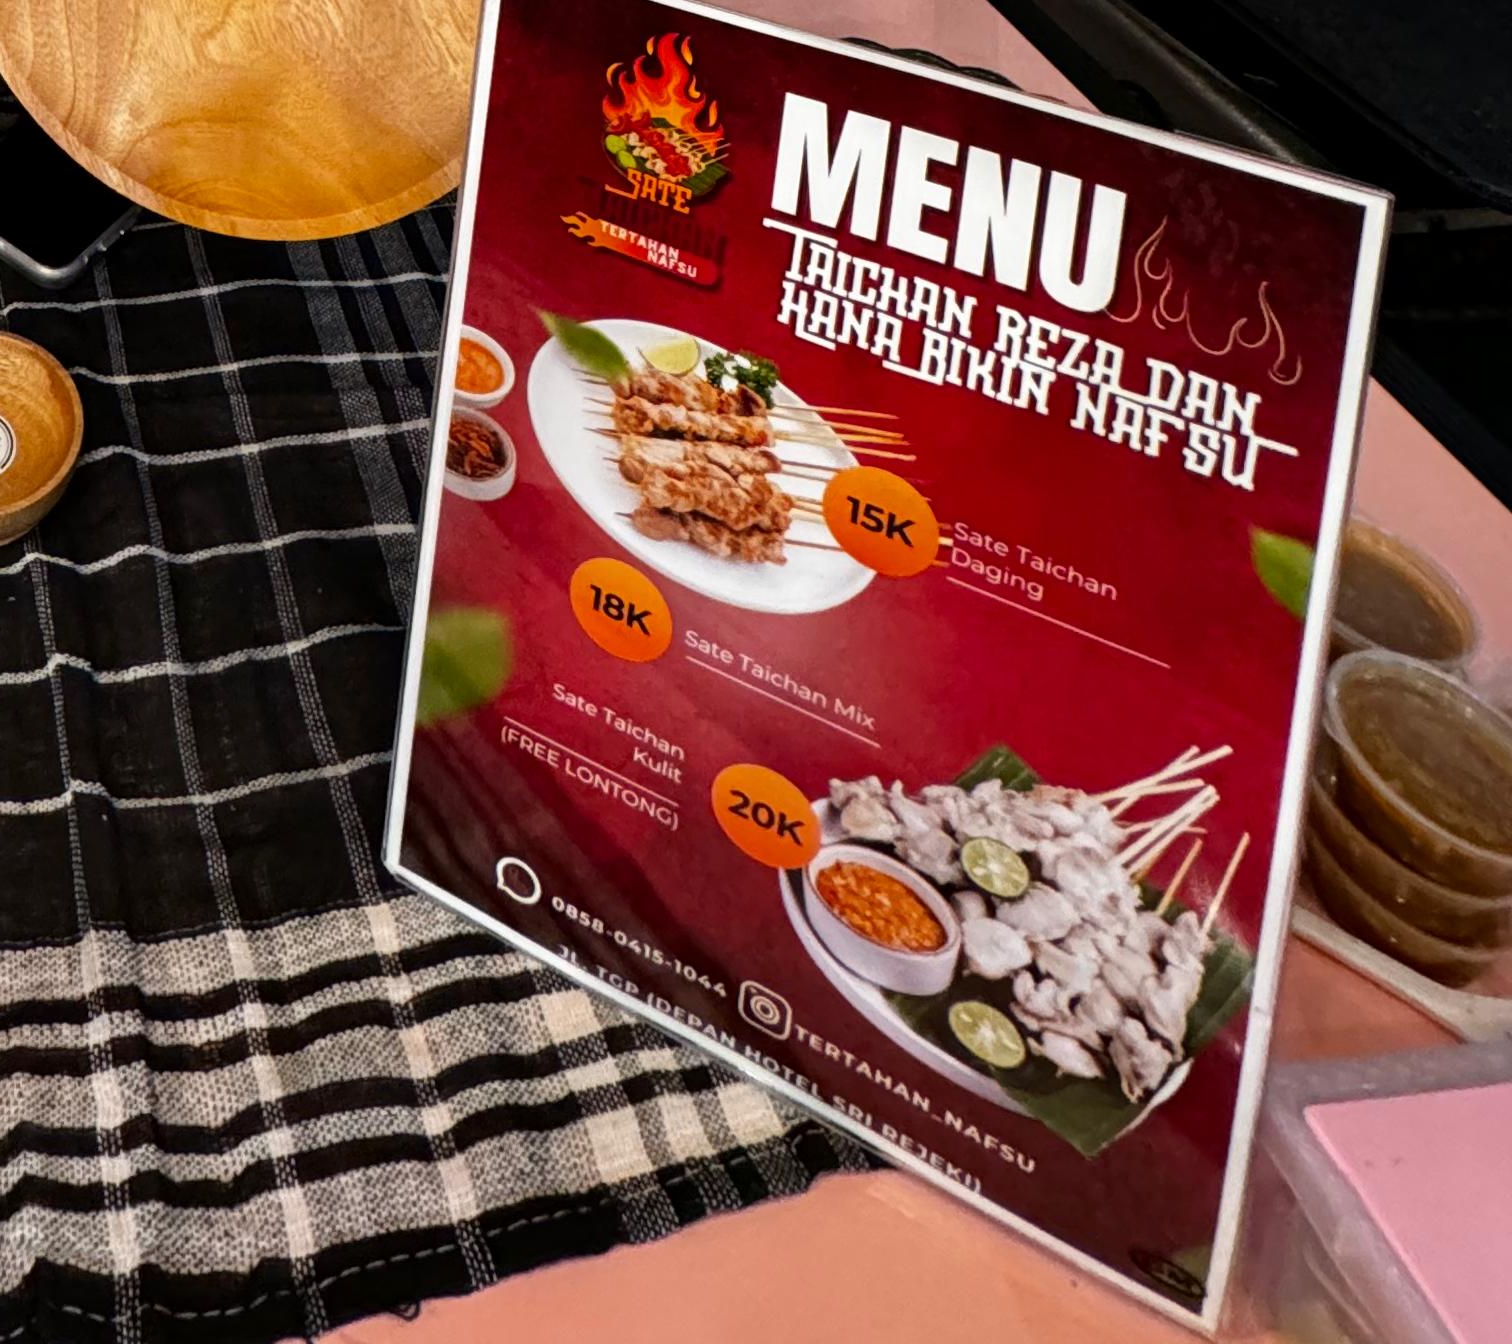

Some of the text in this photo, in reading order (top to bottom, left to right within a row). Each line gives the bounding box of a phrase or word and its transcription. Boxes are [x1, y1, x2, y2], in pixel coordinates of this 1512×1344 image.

[605, 167, 692, 214] SATE
[772, 92, 1127, 313] MENU
[598, 218, 679, 263] TERTAHAN
[648, 250, 697, 278] NAFSU
[762, 217, 1268, 437] TAICHAN REZA DAN
[776, 280, 1280, 492] HANA BIKIN NAFSU
[846, 495, 915, 549] 15K
[950, 546, 1045, 601] Daging
[953, 522, 1119, 601] Sate Taichan
[589, 584, 653, 636] 18K
[684, 630, 877, 732] Sate Taichan Mix
[552, 683, 686, 761] Sate Taichan
[500, 725, 679, 831] (FREE LONTONG)
[632, 747, 682, 784] Kulit
[728, 789, 806, 847] 20K
[551, 896, 728, 998] 0858-0415-1044
[646, 992, 737, 1049] (DEPAN
[744, 1045, 823, 1099] HOTEL
[832, 1095, 873, 1127] SRI
[793, 1023, 1036, 1174] TERTAHAN_NAFSU
